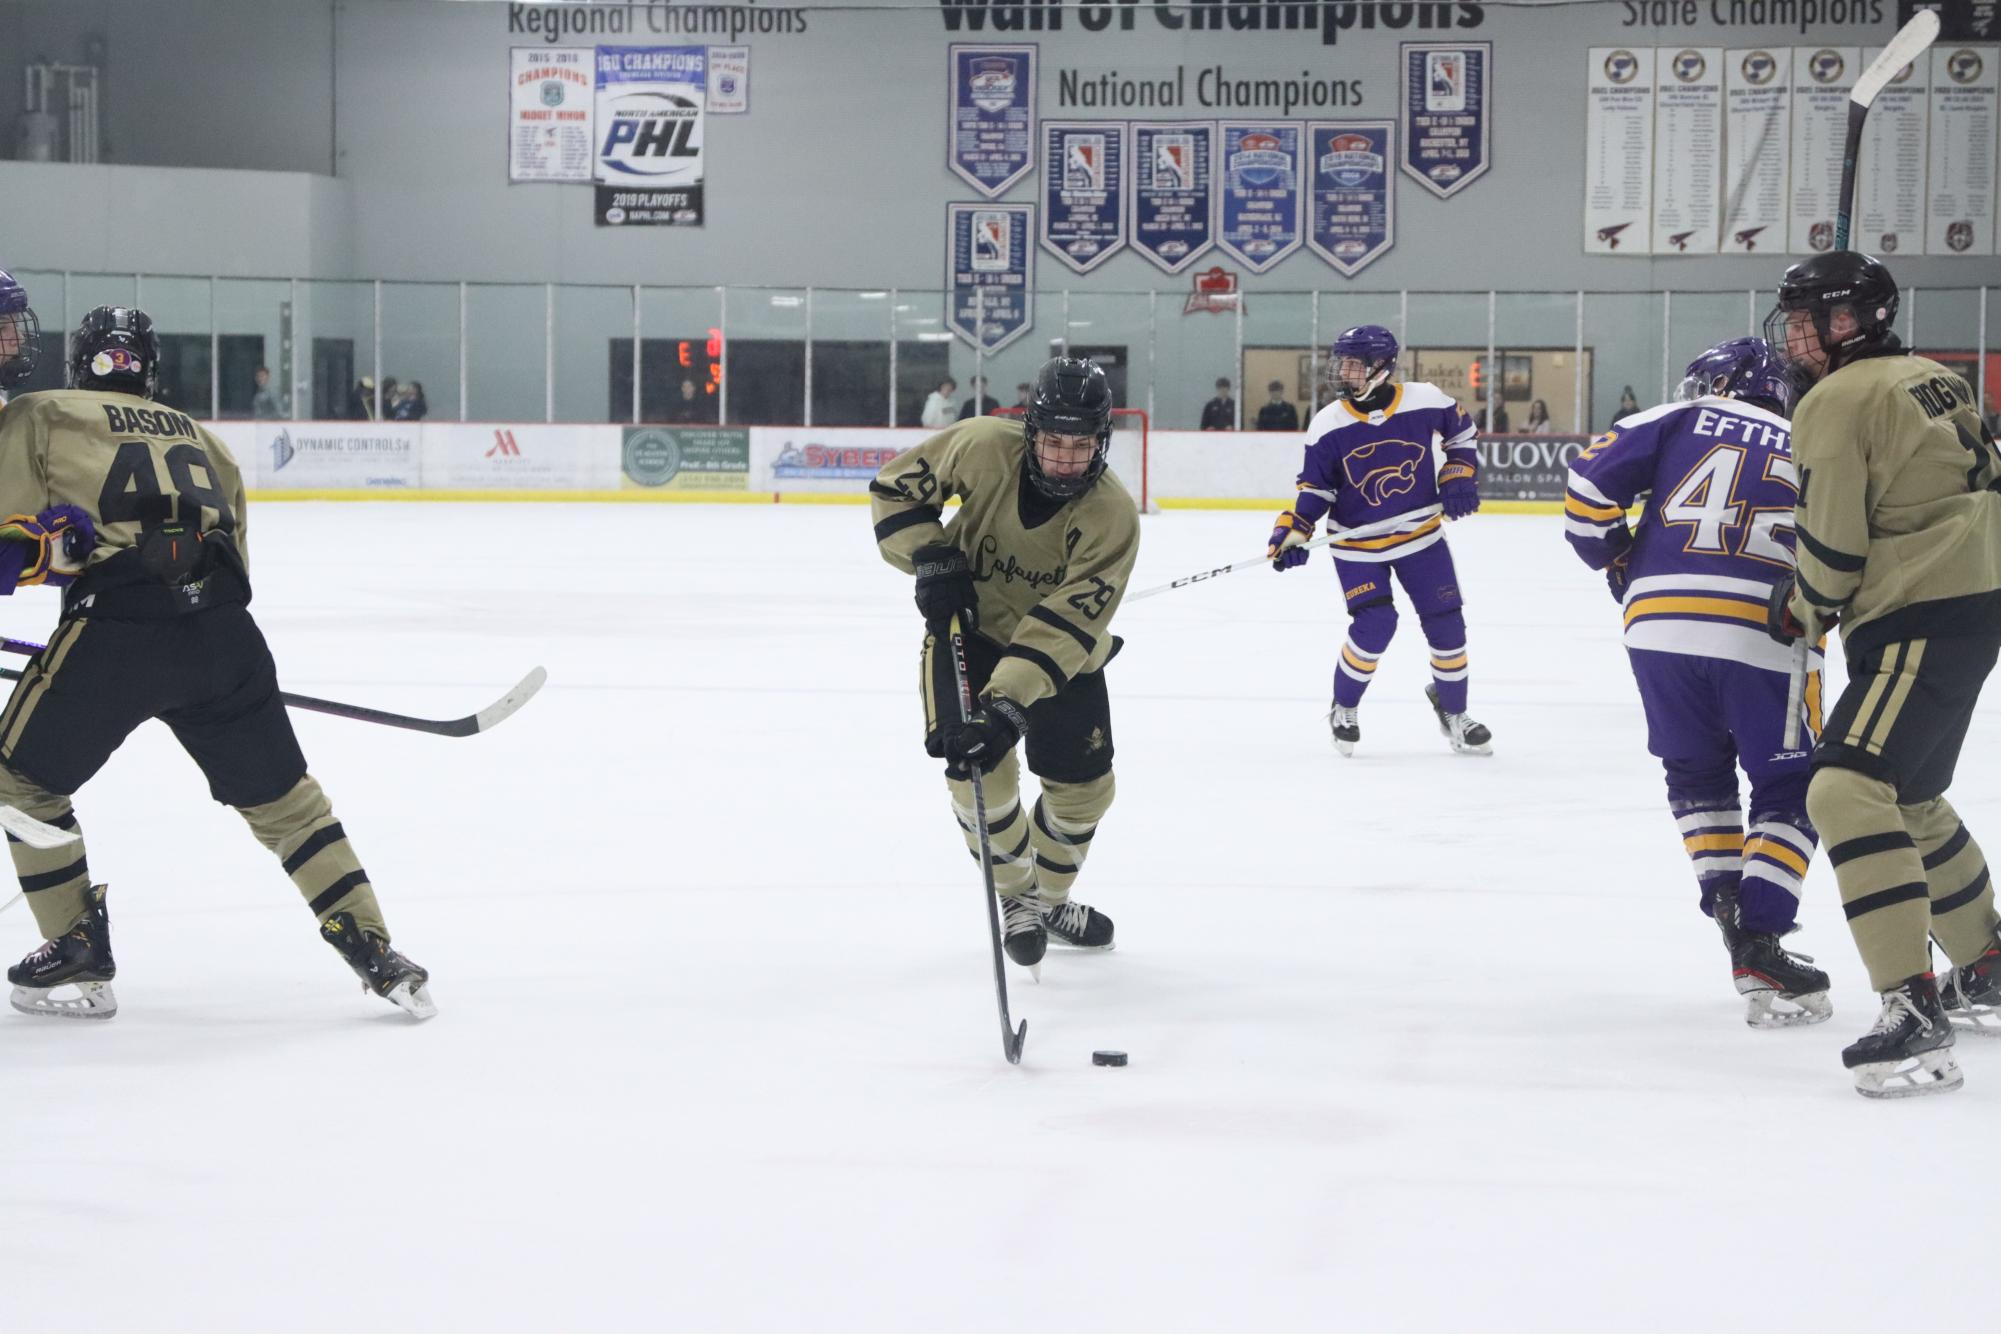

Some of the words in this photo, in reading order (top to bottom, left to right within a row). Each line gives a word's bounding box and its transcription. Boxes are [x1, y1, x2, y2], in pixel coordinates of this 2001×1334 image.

[508, 3, 632, 43] Regional
[647, 3, 808, 42] Champions
[1154, 0, 1485, 45] Champions
[1622, 0, 1698, 26] State
[1711, 0, 1883, 35] Champions
[518, 66, 587, 86] CHAMPIONS
[623, 54, 703, 72] CHAMPIONS
[1059, 65, 1183, 107] National
[1198, 65, 1363, 116] Champions
[600, 119, 701, 157] PHL
[613, 193, 637, 207] 2019
[638, 193, 688, 207] PLAYOFFS
[1822, 289, 1851, 299] CCM
[102, 405, 197, 440] BASOM
[296, 437, 343, 450] DYNAMIC
[347, 437, 401, 450] CONTROLS
[98, 441, 236, 545] 48
[895, 457, 937, 503] 29
[1487, 473, 1531, 483] SALON
[1537, 473, 1563, 483] SPA
[1660, 443, 1799, 571] 42
[1171, 564, 1232, 589] CCM
[1345, 581, 1377, 600] EUREKA
[1067, 576, 1115, 620] 29
